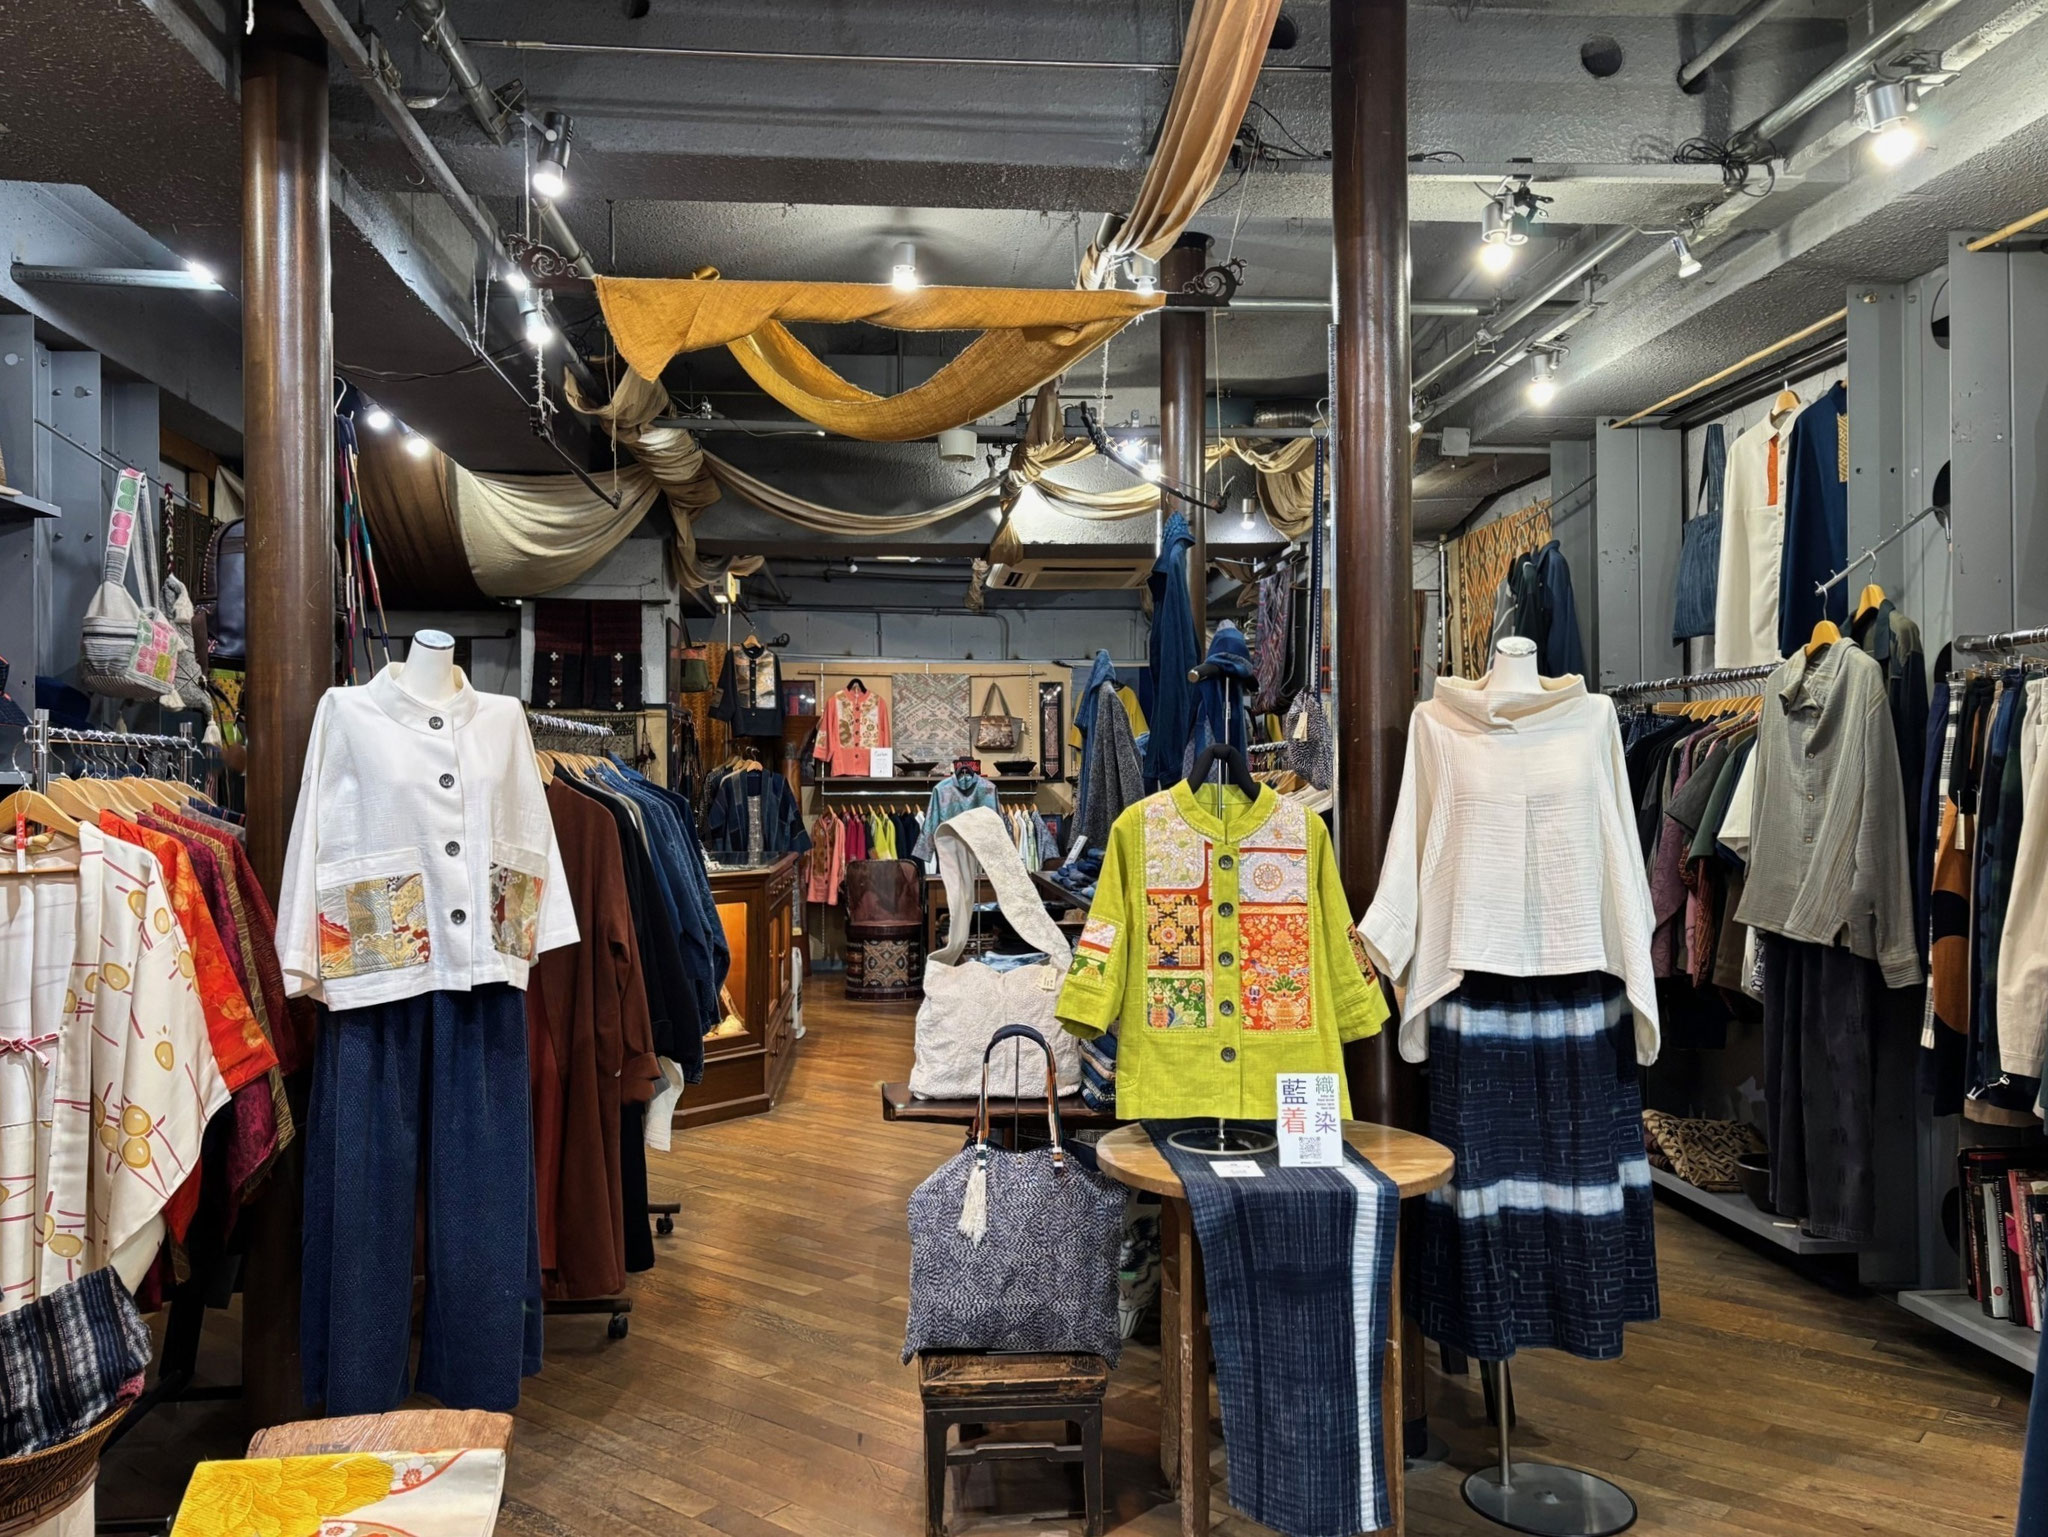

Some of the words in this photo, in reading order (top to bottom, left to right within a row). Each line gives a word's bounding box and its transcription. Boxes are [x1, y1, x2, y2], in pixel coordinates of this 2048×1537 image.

[1281, 1078, 1308, 1104] 藍
[1315, 1076, 1335, 1094] 織
[1281, 1107, 1308, 1134] 着
[1315, 1111, 1337, 1134] 染
